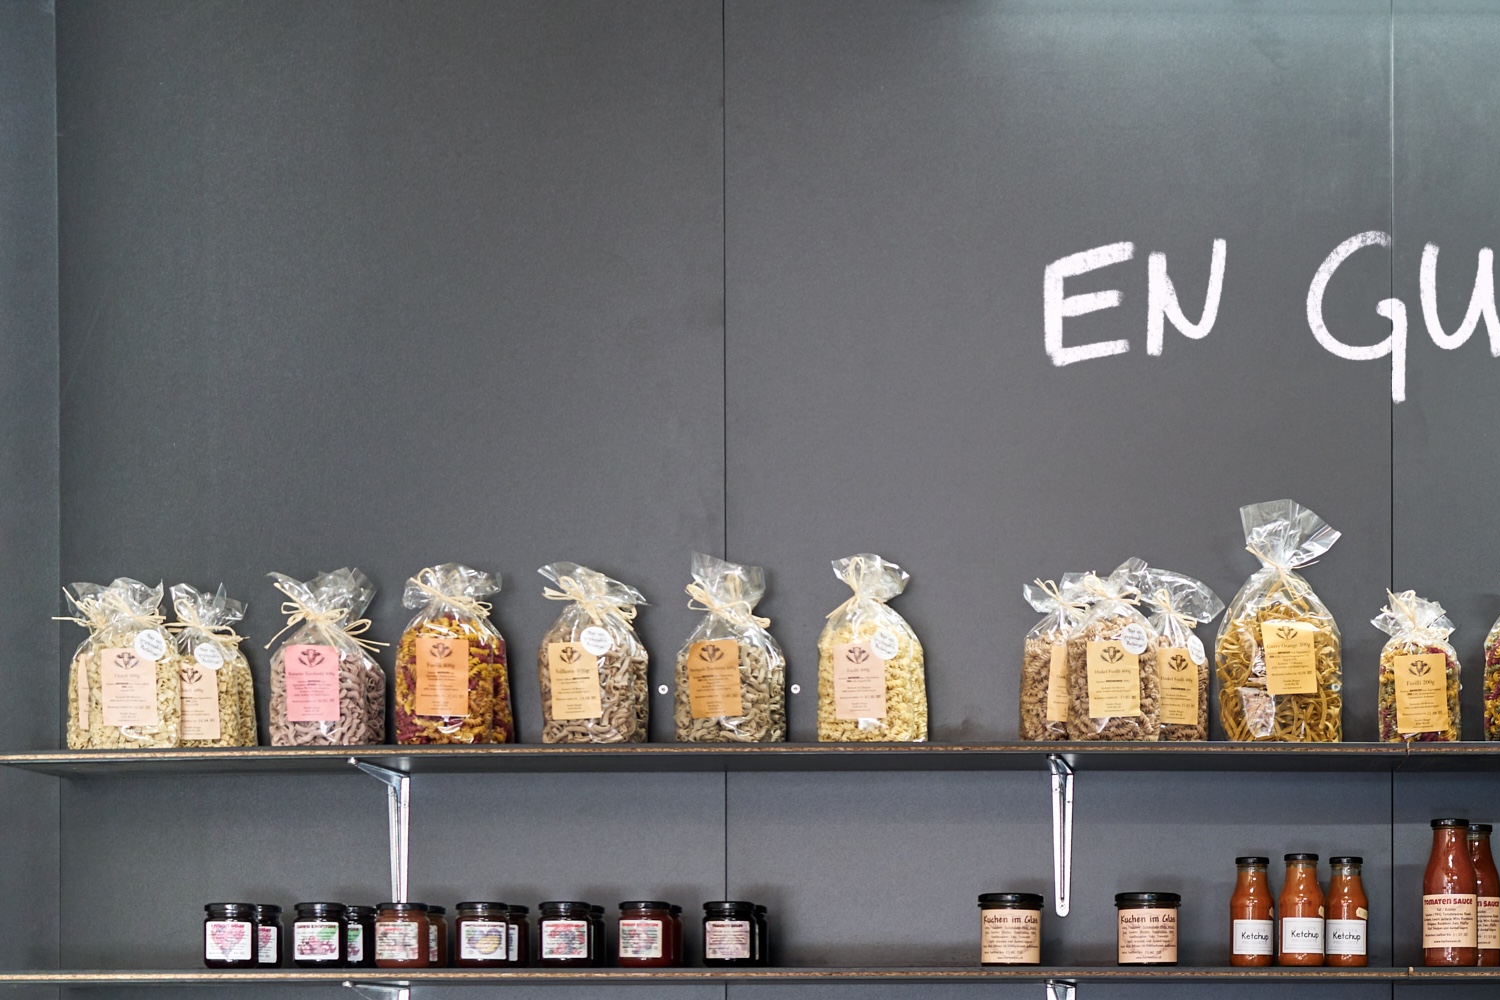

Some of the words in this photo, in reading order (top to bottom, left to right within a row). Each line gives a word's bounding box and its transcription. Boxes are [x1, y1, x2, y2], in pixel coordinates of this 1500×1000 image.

[1043, 238, 1228, 367] EN
[1483, 900, 1500, 908] SAUCE
[983, 915, 1008, 925] Kuchen
[1024, 915, 1039, 924] Glas
[1121, 915, 1146, 925] Kuchen
[1162, 915, 1176, 924] Glas
[1241, 931, 1269, 941] Ketchup
[1291, 930, 1320, 939] Ketchup
[1332, 931, 1361, 941] Ketchup
